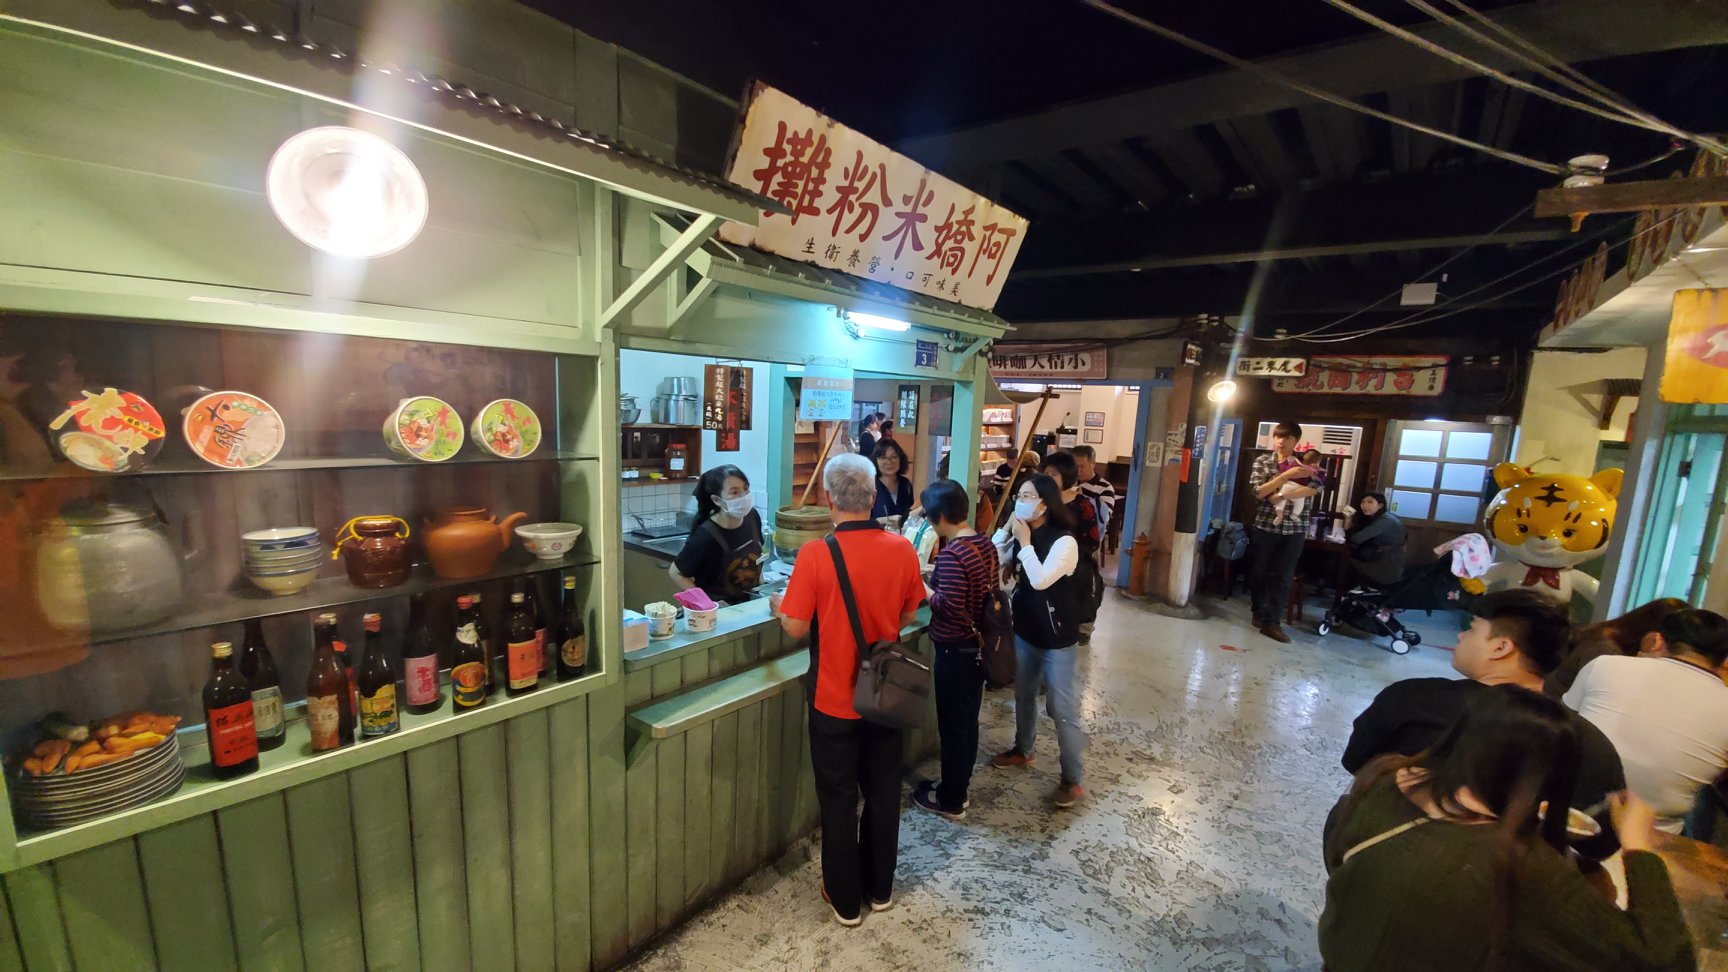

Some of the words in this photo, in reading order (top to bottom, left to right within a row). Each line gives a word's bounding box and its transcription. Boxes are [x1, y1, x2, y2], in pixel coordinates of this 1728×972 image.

[753, 120, 1017, 287] 阿嬌米粉攤
[921, 353, 927, 365] 3
[989, 350, 1086, 370] 小情人咖啡
